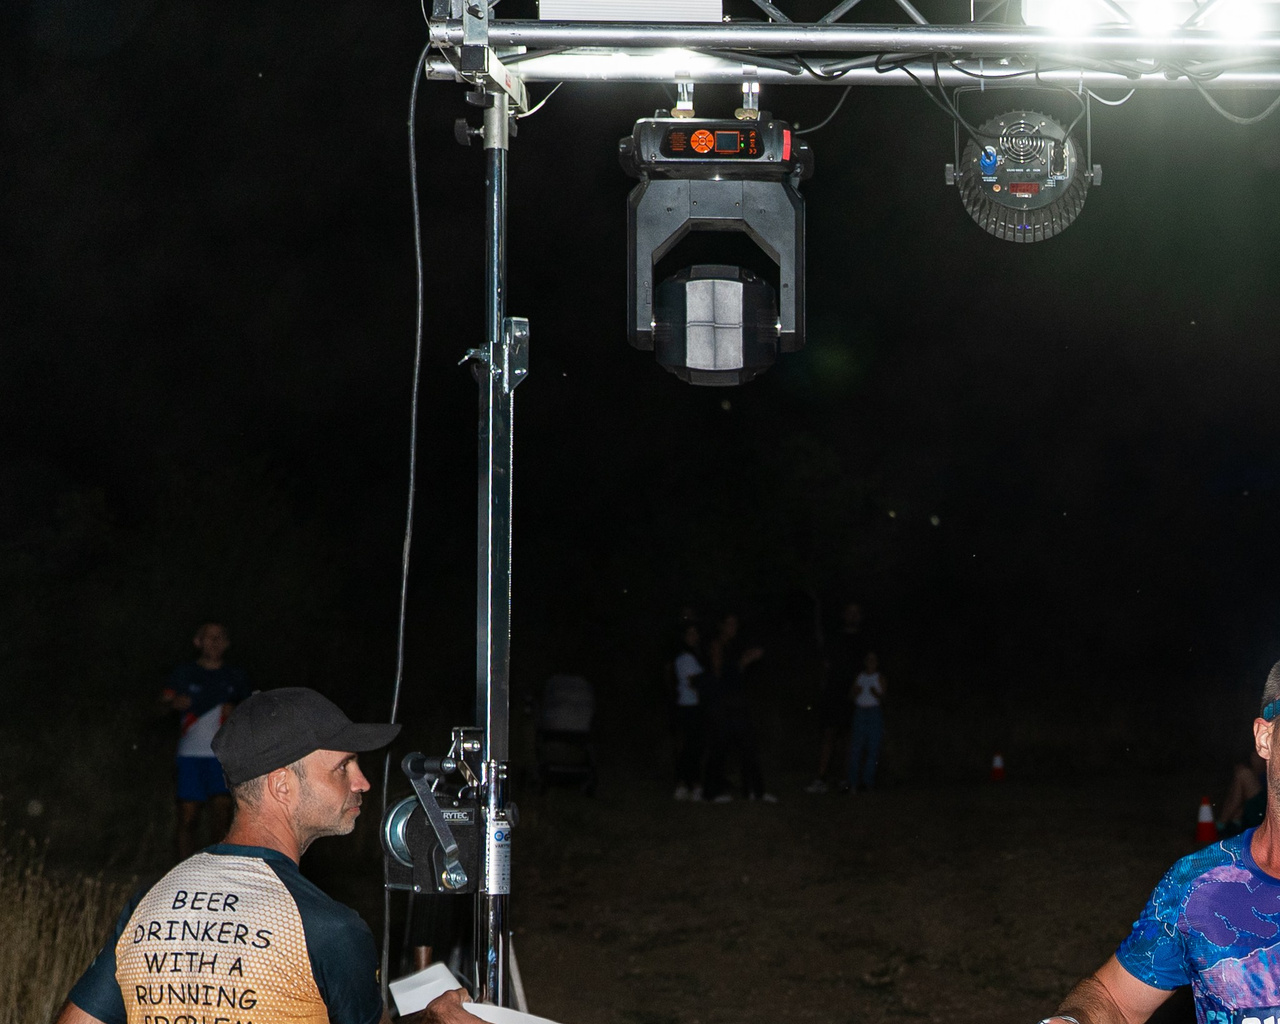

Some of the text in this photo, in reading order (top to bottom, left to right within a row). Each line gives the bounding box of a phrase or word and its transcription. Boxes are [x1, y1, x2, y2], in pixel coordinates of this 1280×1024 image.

[171, 890, 239, 912] BEER
[133, 919, 273, 949] DRINKERS
[144, 952, 243, 977] WITH A
[135, 985, 258, 1010] RUNNING
